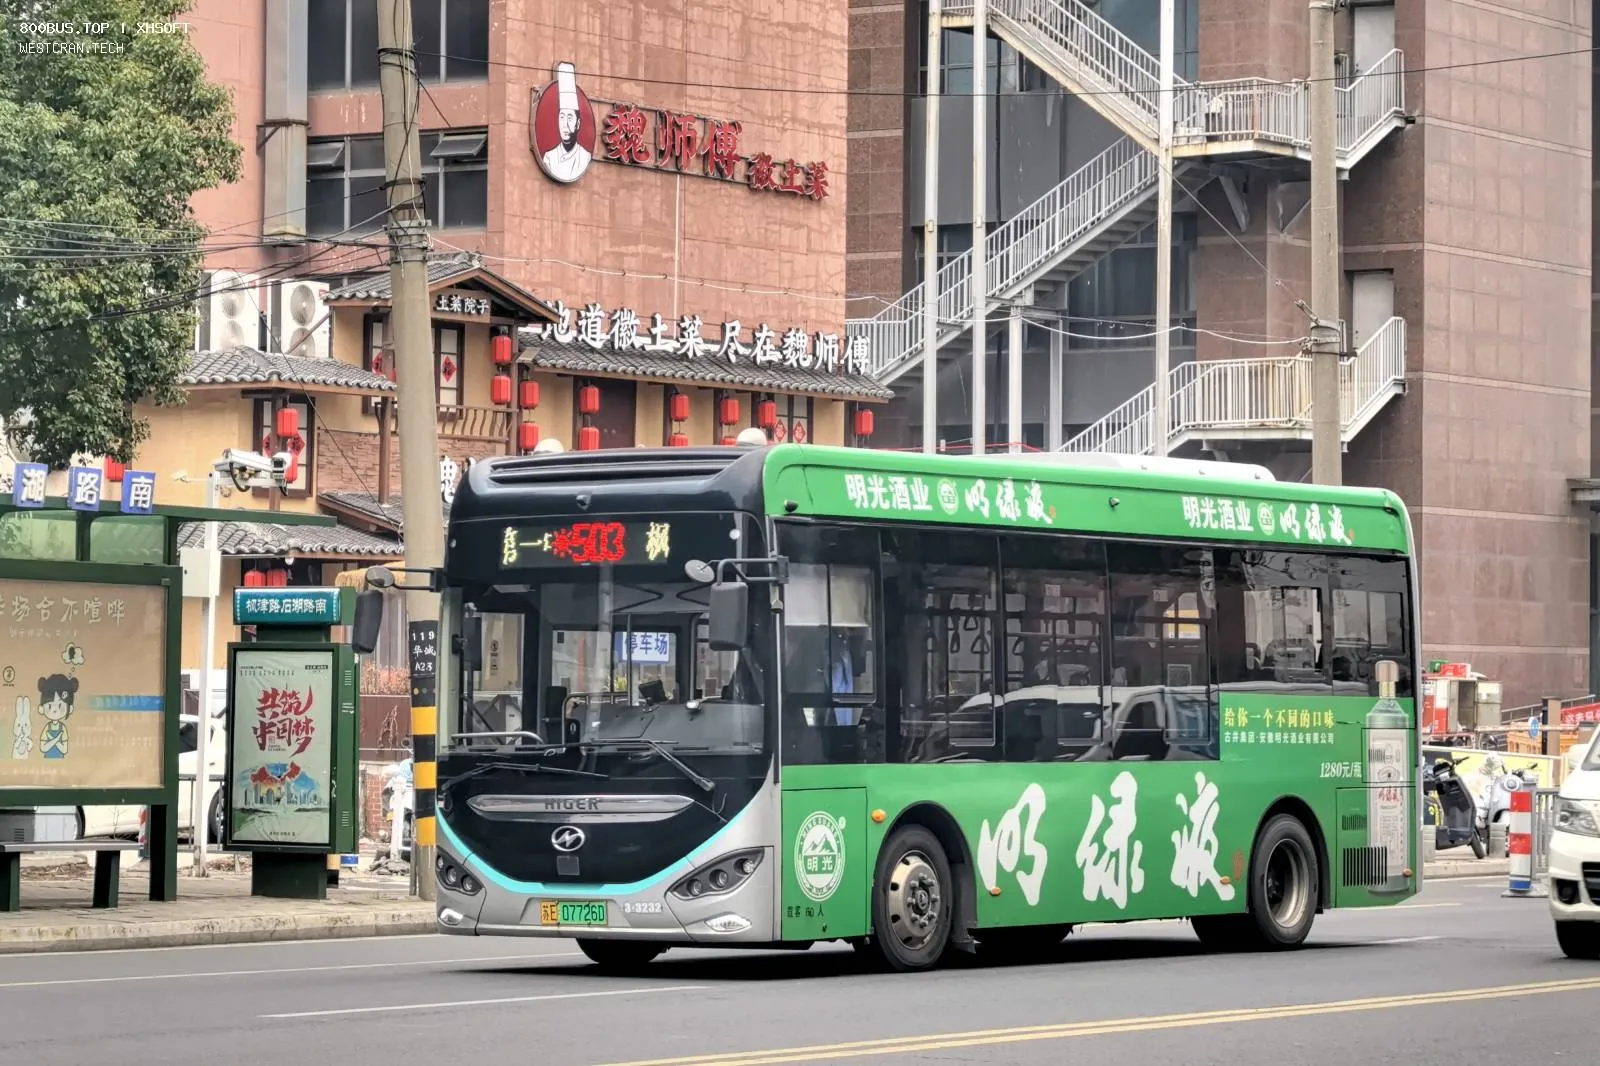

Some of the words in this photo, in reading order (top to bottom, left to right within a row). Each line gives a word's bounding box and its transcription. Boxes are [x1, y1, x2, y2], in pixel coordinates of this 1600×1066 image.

[603, 103, 743, 179] 魏师傅
[750, 152, 829, 200] 徽土菜
[436, 295, 490, 314] 土菜院子
[540, 300, 707, 359] 地道徽土菜
[716, 319, 871, 376] 尽在魏师傅
[20, 467, 154, 510] 湖路南
[844, 473, 933, 511] 明光酒业
[1182, 495, 1254, 532] 明光酒业
[571, 522, 625, 562] 503
[0, 594, 126, 627] 场合不喧哗
[412, 630, 436, 641] 119
[415, 661, 433, 672] A23
[256, 684, 314, 720] 共筑
[1224, 707, 1336, 729] 给你一个不同的口味
[252, 715, 316, 759] 中国梦
[544, 798, 600, 811] HIGER
[806, 855, 833, 872] 明光
[541, 904, 557, 921] 苏E
